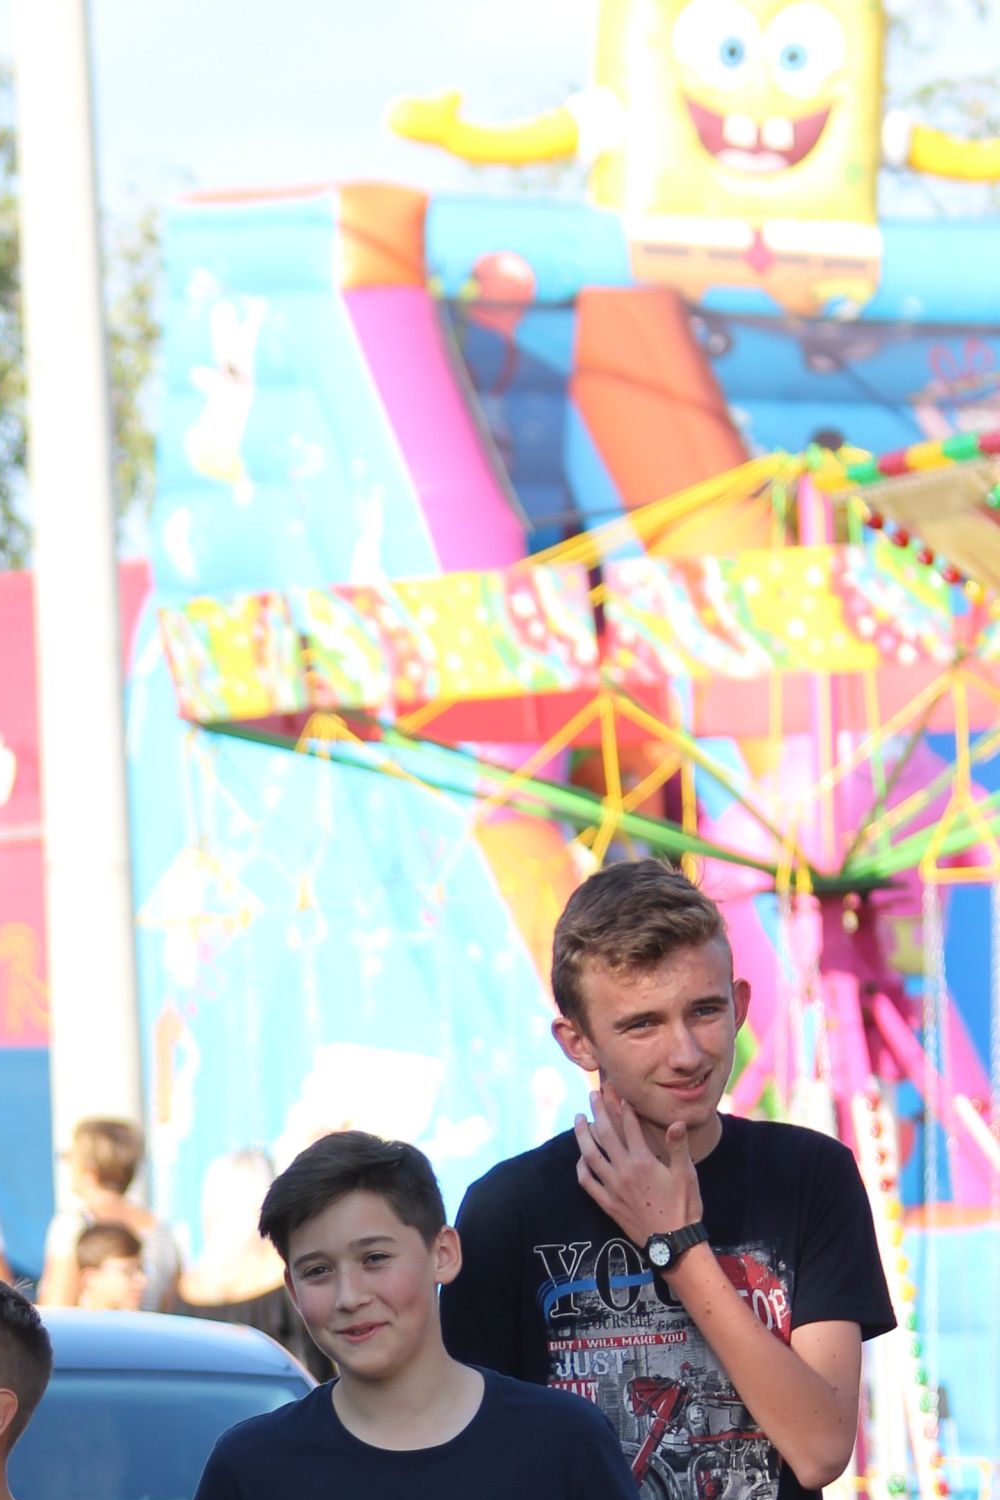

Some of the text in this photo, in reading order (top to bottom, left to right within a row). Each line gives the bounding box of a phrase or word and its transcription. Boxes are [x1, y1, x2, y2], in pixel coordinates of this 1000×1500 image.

[550, 1340, 574, 1351] BUT
[586, 1336, 618, 1349] WILL
[621, 1335, 656, 1346] MAKE
[660, 1332, 684, 1344] YOU
[556, 1349, 628, 1377] JUST
